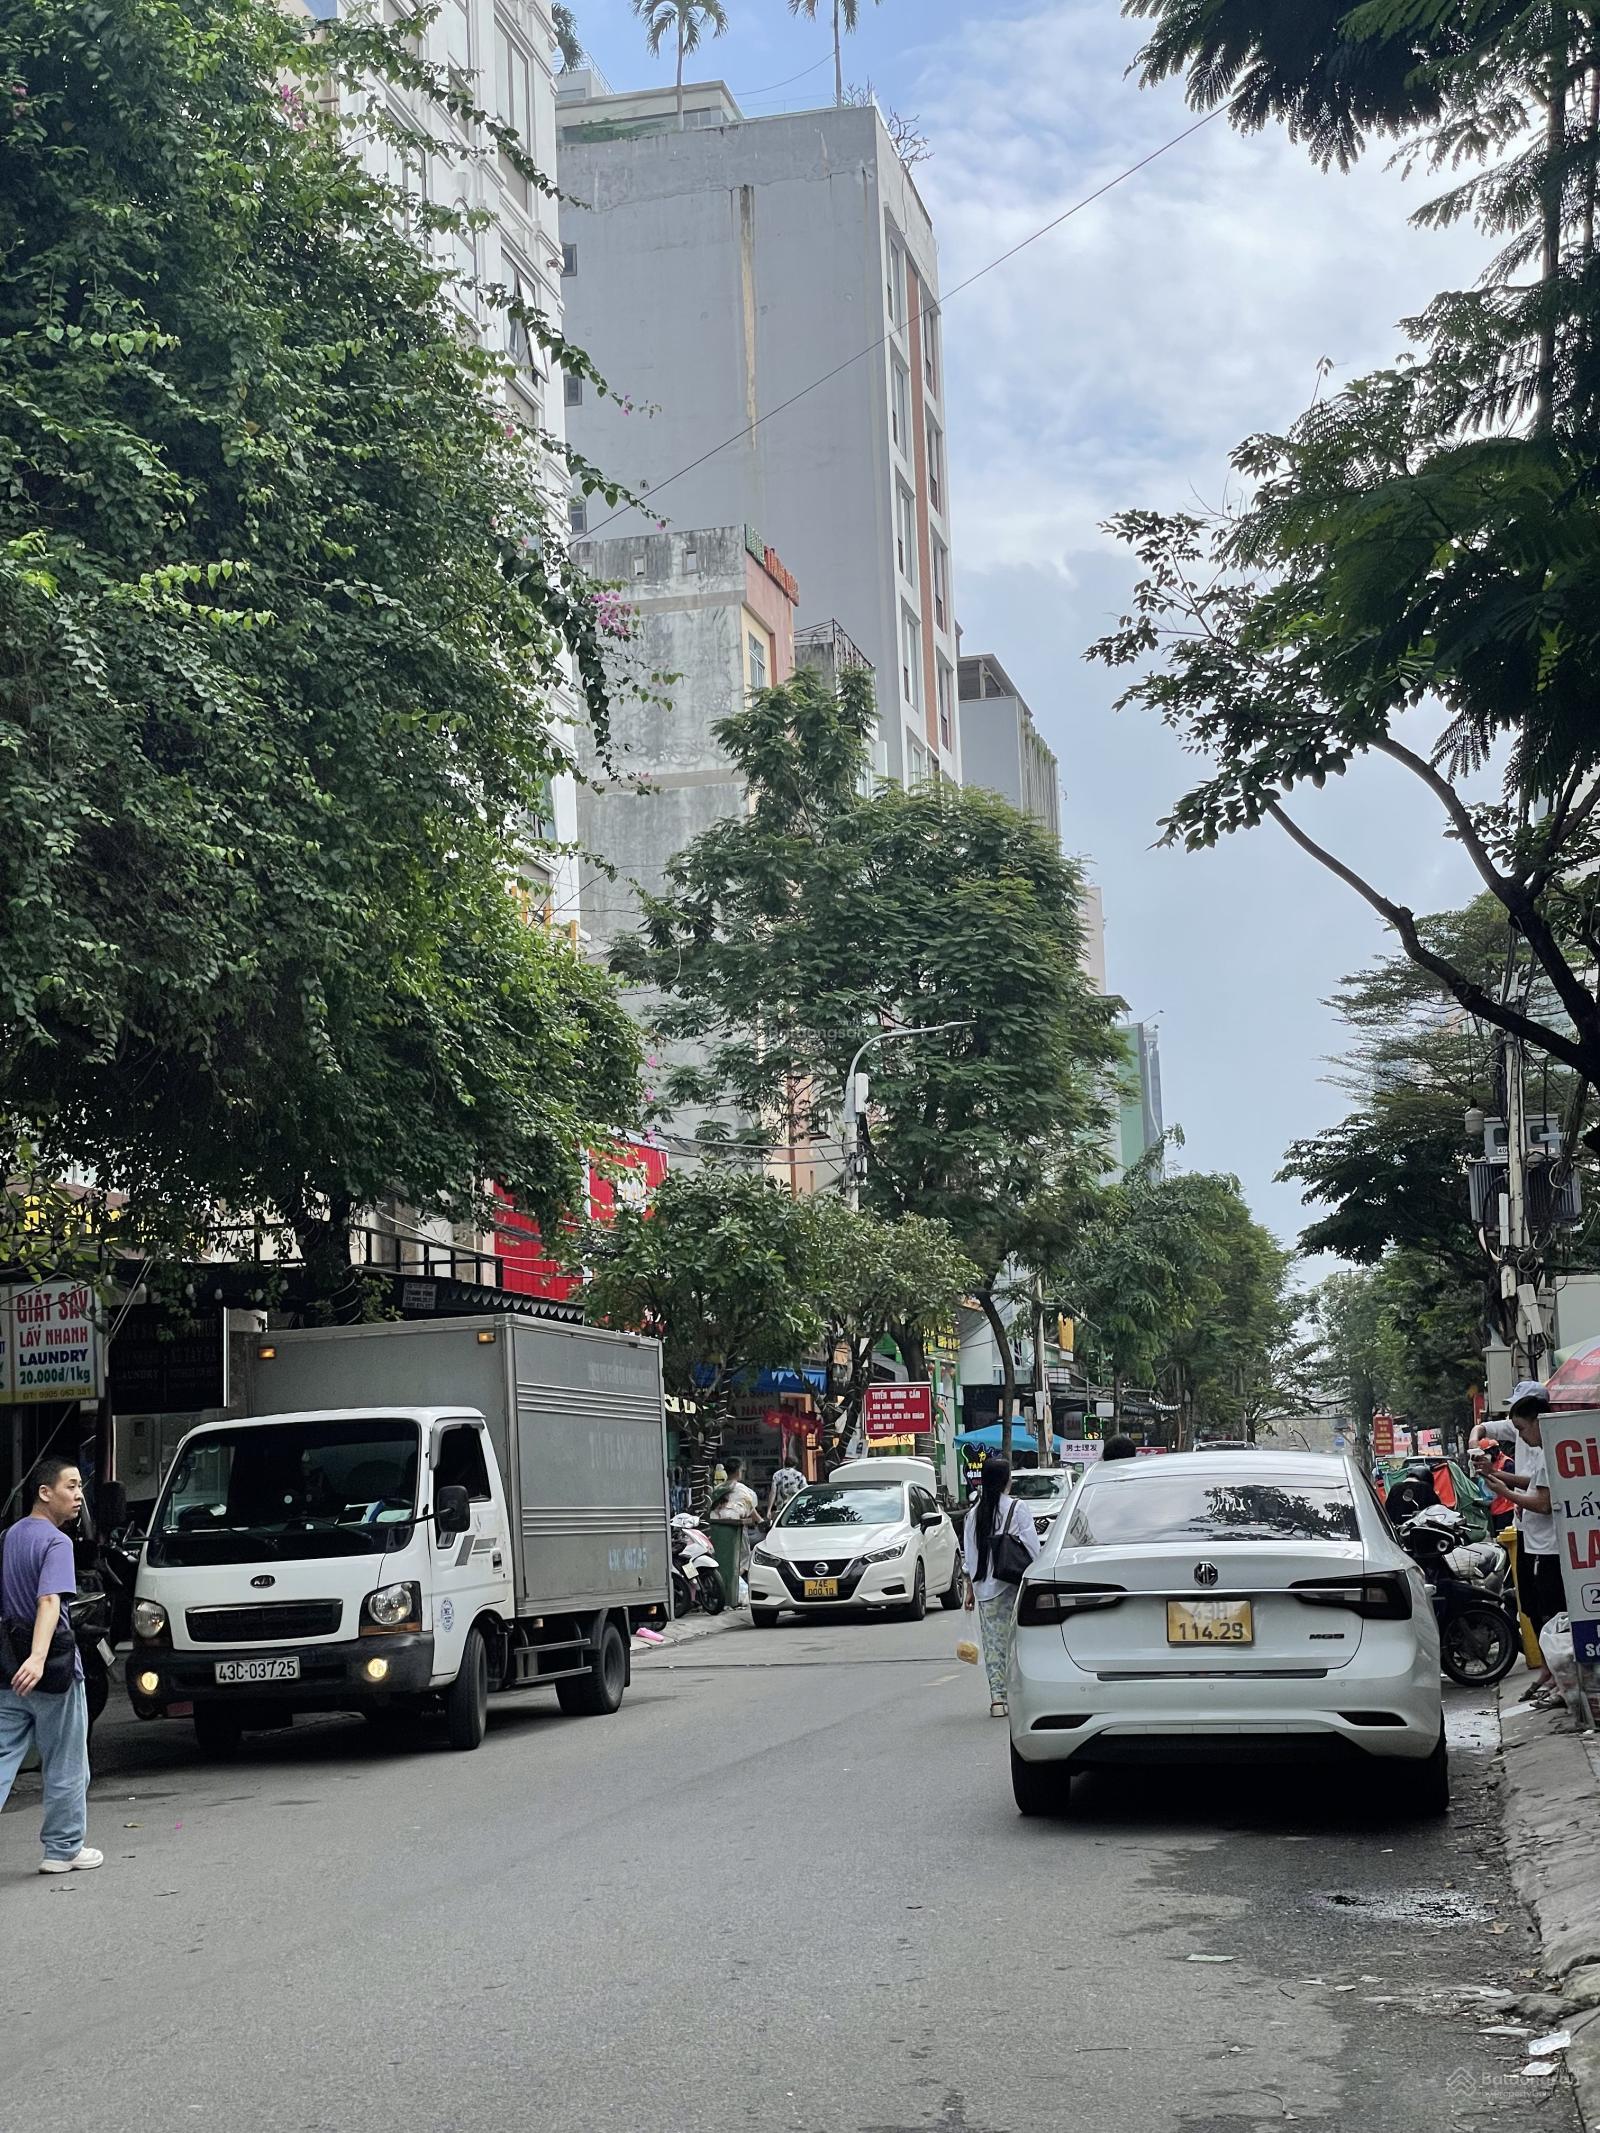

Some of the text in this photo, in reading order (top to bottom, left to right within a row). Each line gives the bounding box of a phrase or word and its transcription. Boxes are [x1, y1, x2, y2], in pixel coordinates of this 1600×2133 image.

[46, 1327, 88, 1346] NHANH
[19, 1349, 88, 1367] LAUNDRY
[20, 1366, 90, 1385] 20.000đ/1kg
[1066, 1443, 1098, 1452] 男士理发
[1178, 1622, 1244, 1640] 114.29
[219, 1660, 296, 1681] 43C-037.25
